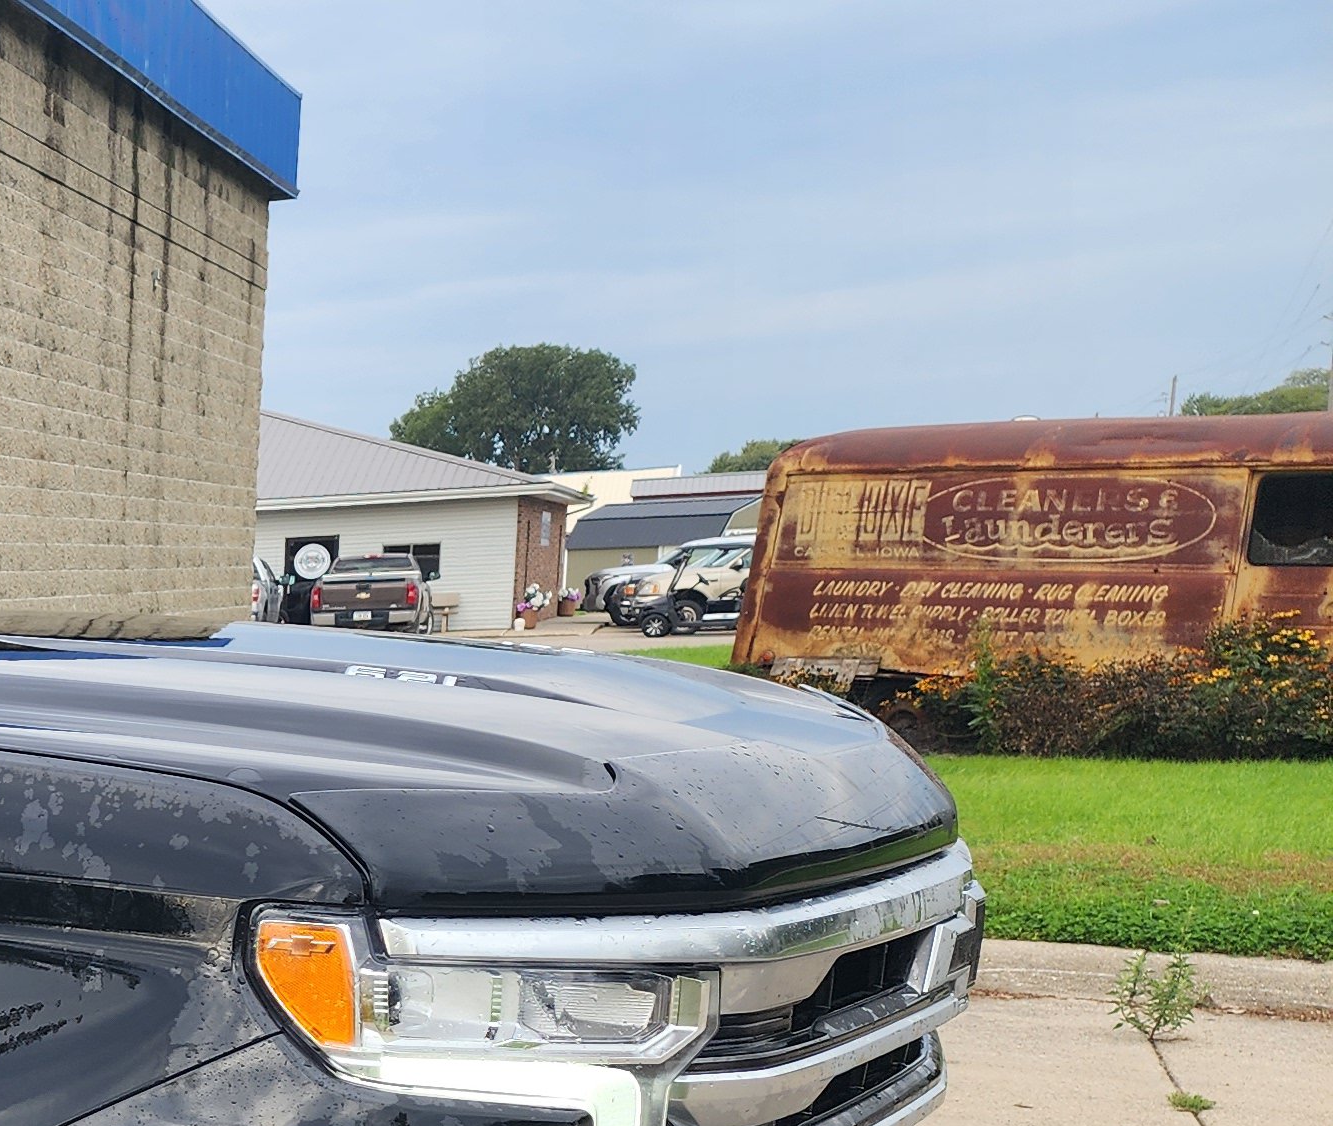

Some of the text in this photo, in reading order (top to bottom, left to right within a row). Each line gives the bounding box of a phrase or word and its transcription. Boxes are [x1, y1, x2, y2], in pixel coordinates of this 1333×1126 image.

[952, 488, 1149, 513] CLEANERS
[875, 547, 920, 558] IOWA
[813, 580, 1169, 603] LAUNDRY DRY CLEANING RUG CLEANING
[983, 606, 1041, 624] ROLLER
[1103, 610, 1167, 628] BOXES
